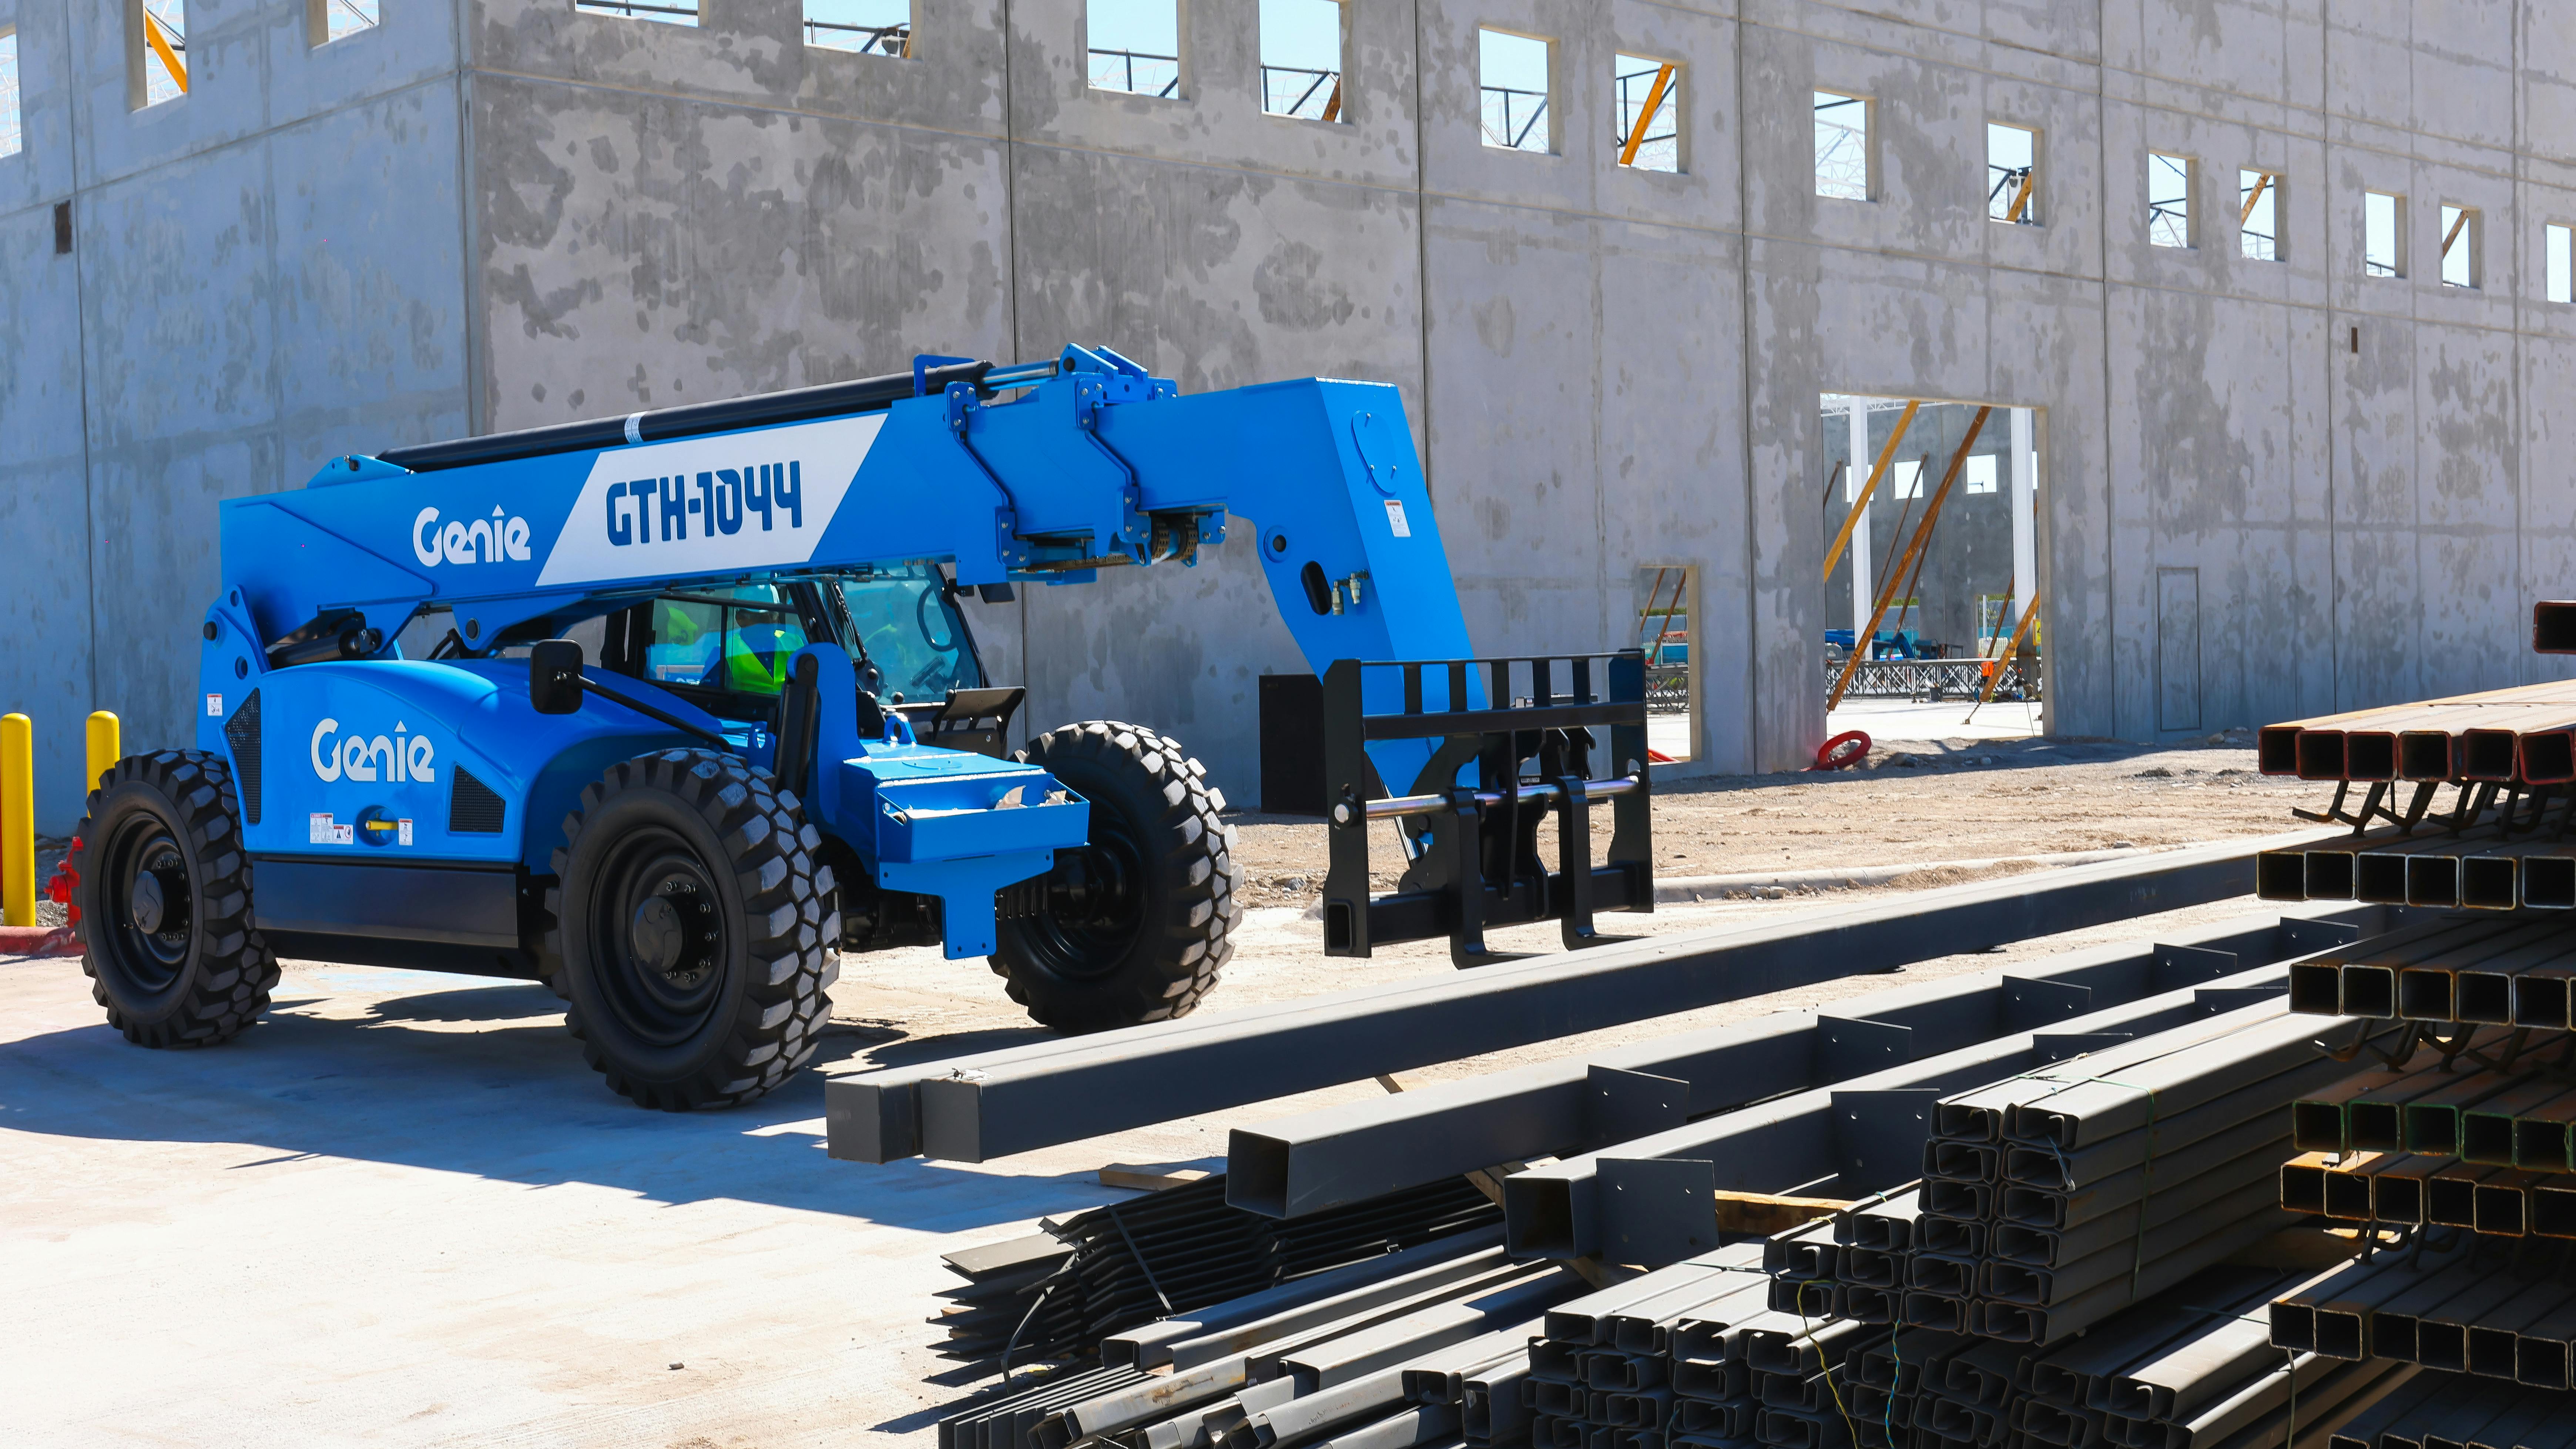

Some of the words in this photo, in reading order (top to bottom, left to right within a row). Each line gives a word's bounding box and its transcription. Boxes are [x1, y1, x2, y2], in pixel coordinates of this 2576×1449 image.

[413, 504, 531, 567] Genie
[606, 460, 802, 547] GTH-1044
[311, 718, 435, 782] Genie
